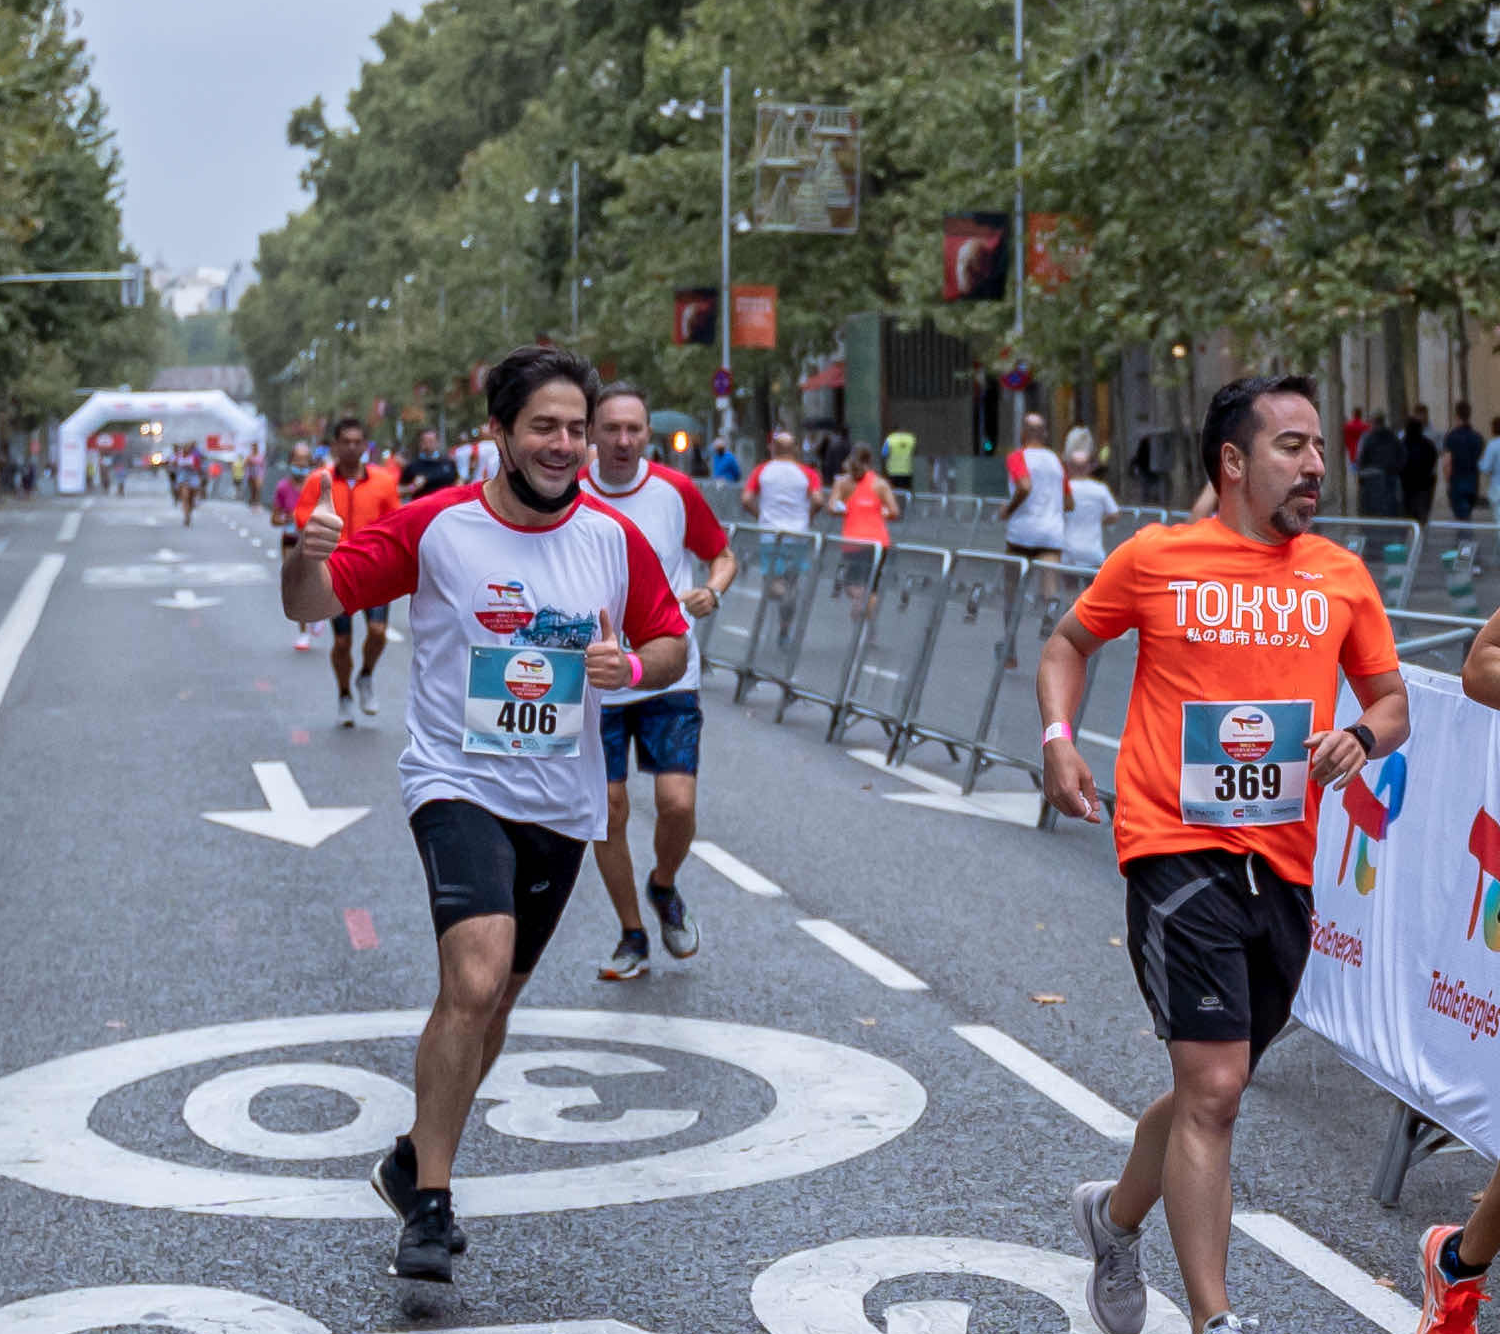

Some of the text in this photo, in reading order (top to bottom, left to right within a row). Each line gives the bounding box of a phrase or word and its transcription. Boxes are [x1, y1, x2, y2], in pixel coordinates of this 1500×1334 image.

[1168, 580, 1329, 636] TOKYO
[1186, 627, 1311, 649] 私の都市 私のジム
[497, 701, 558, 735] 406
[1214, 763, 1282, 801] 369
